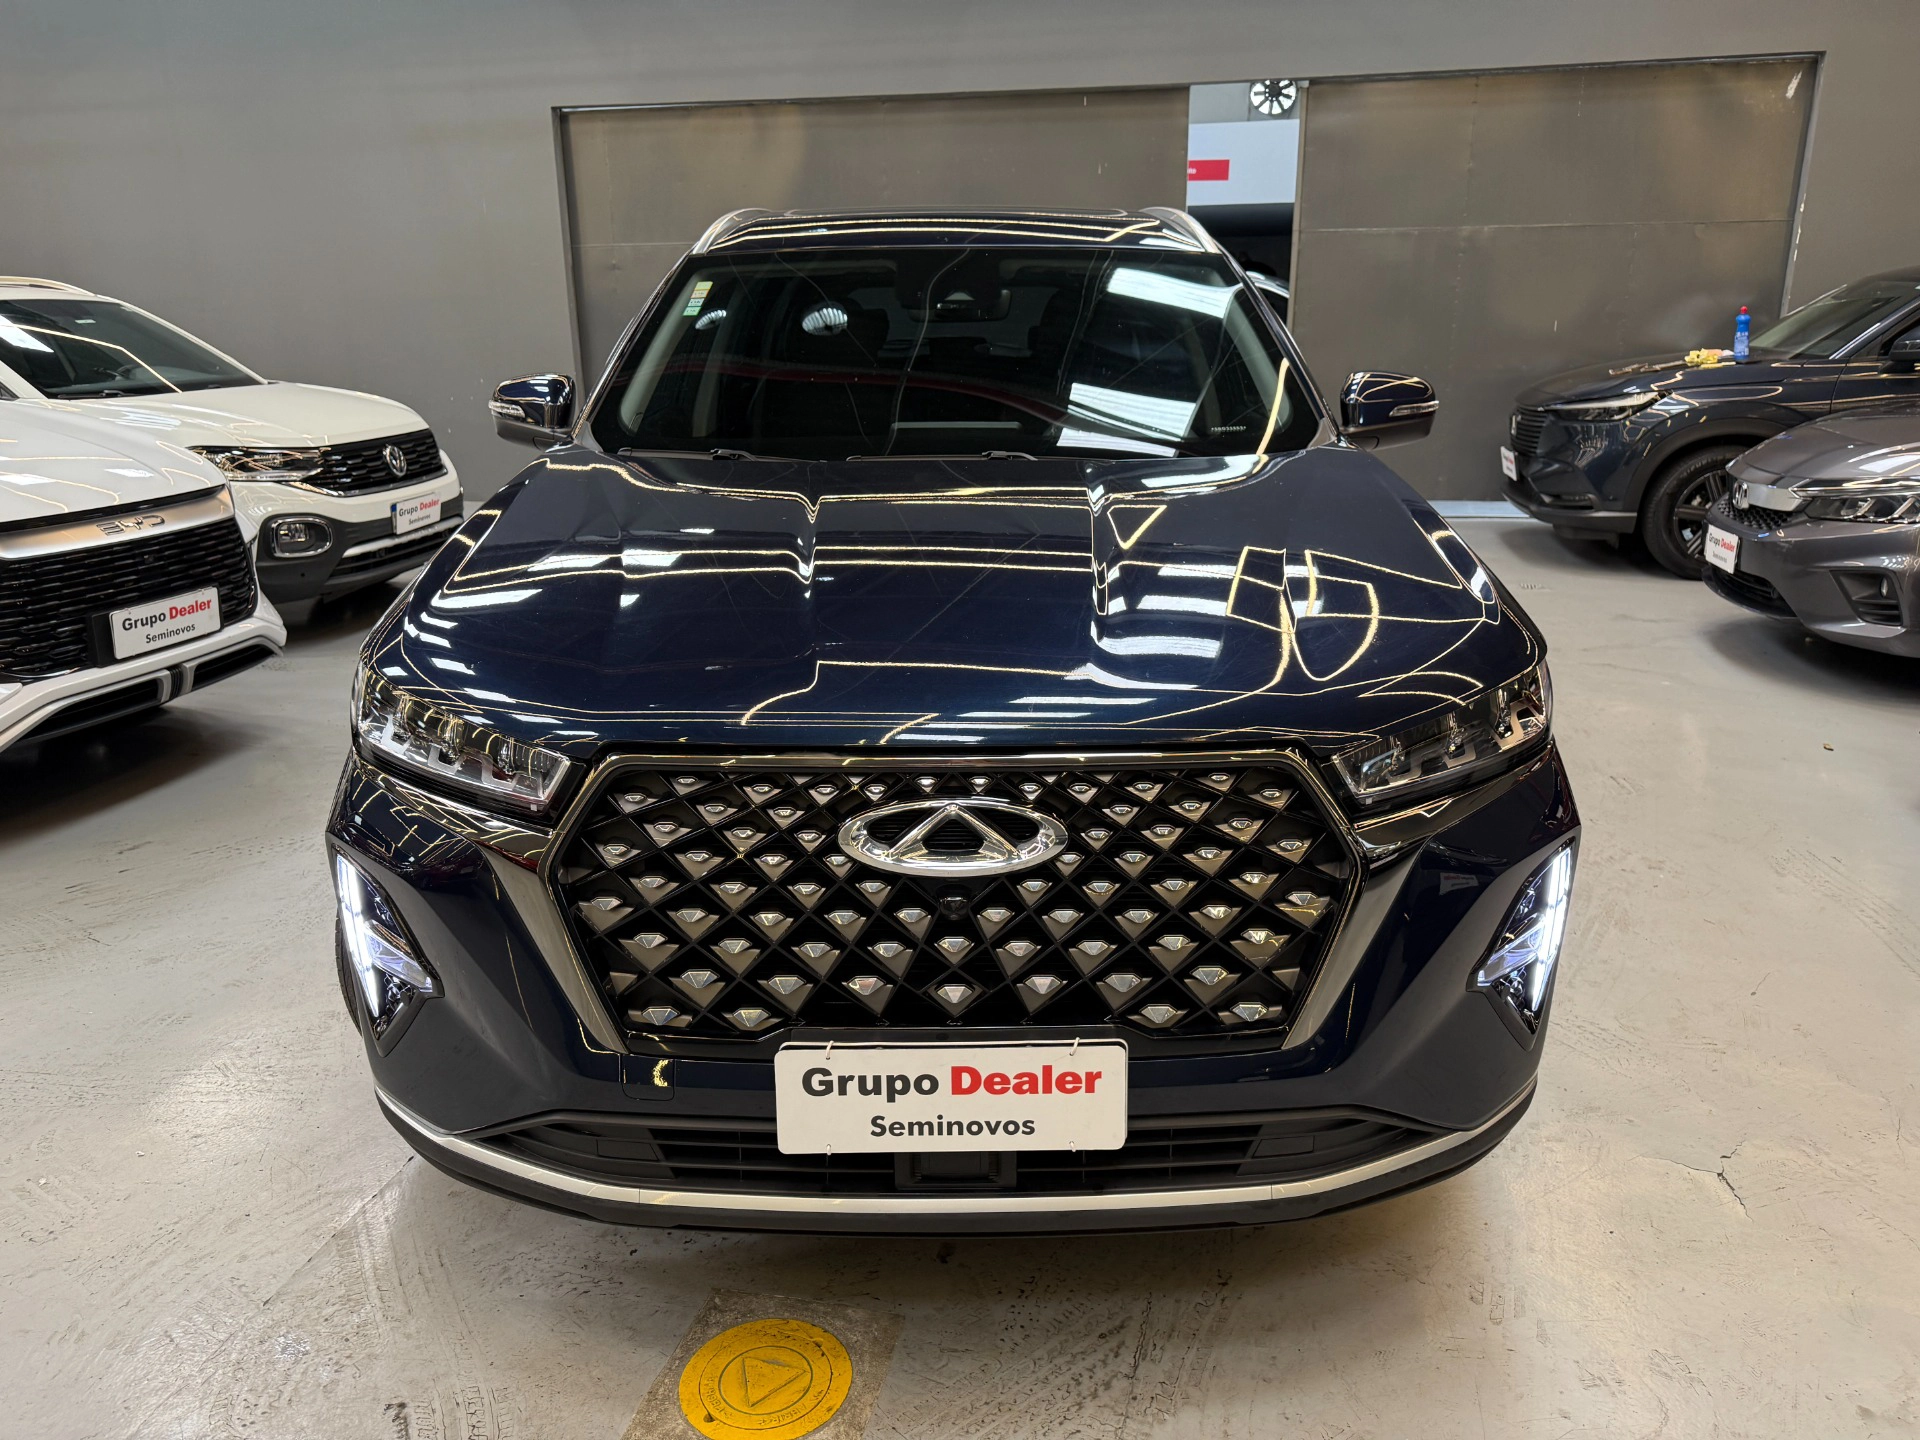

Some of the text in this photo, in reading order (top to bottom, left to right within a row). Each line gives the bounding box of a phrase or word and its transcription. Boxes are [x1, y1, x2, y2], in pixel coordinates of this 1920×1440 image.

[398, 498, 440, 517] Grupo Dealer
[96, 514, 166, 537] BYD
[122, 598, 213, 632] Grupo Dealer
[145, 623, 196, 644] Seminovos
[801, 1065, 1102, 1103] Grupo Dealer
[870, 1114, 1036, 1137] Seminovos
